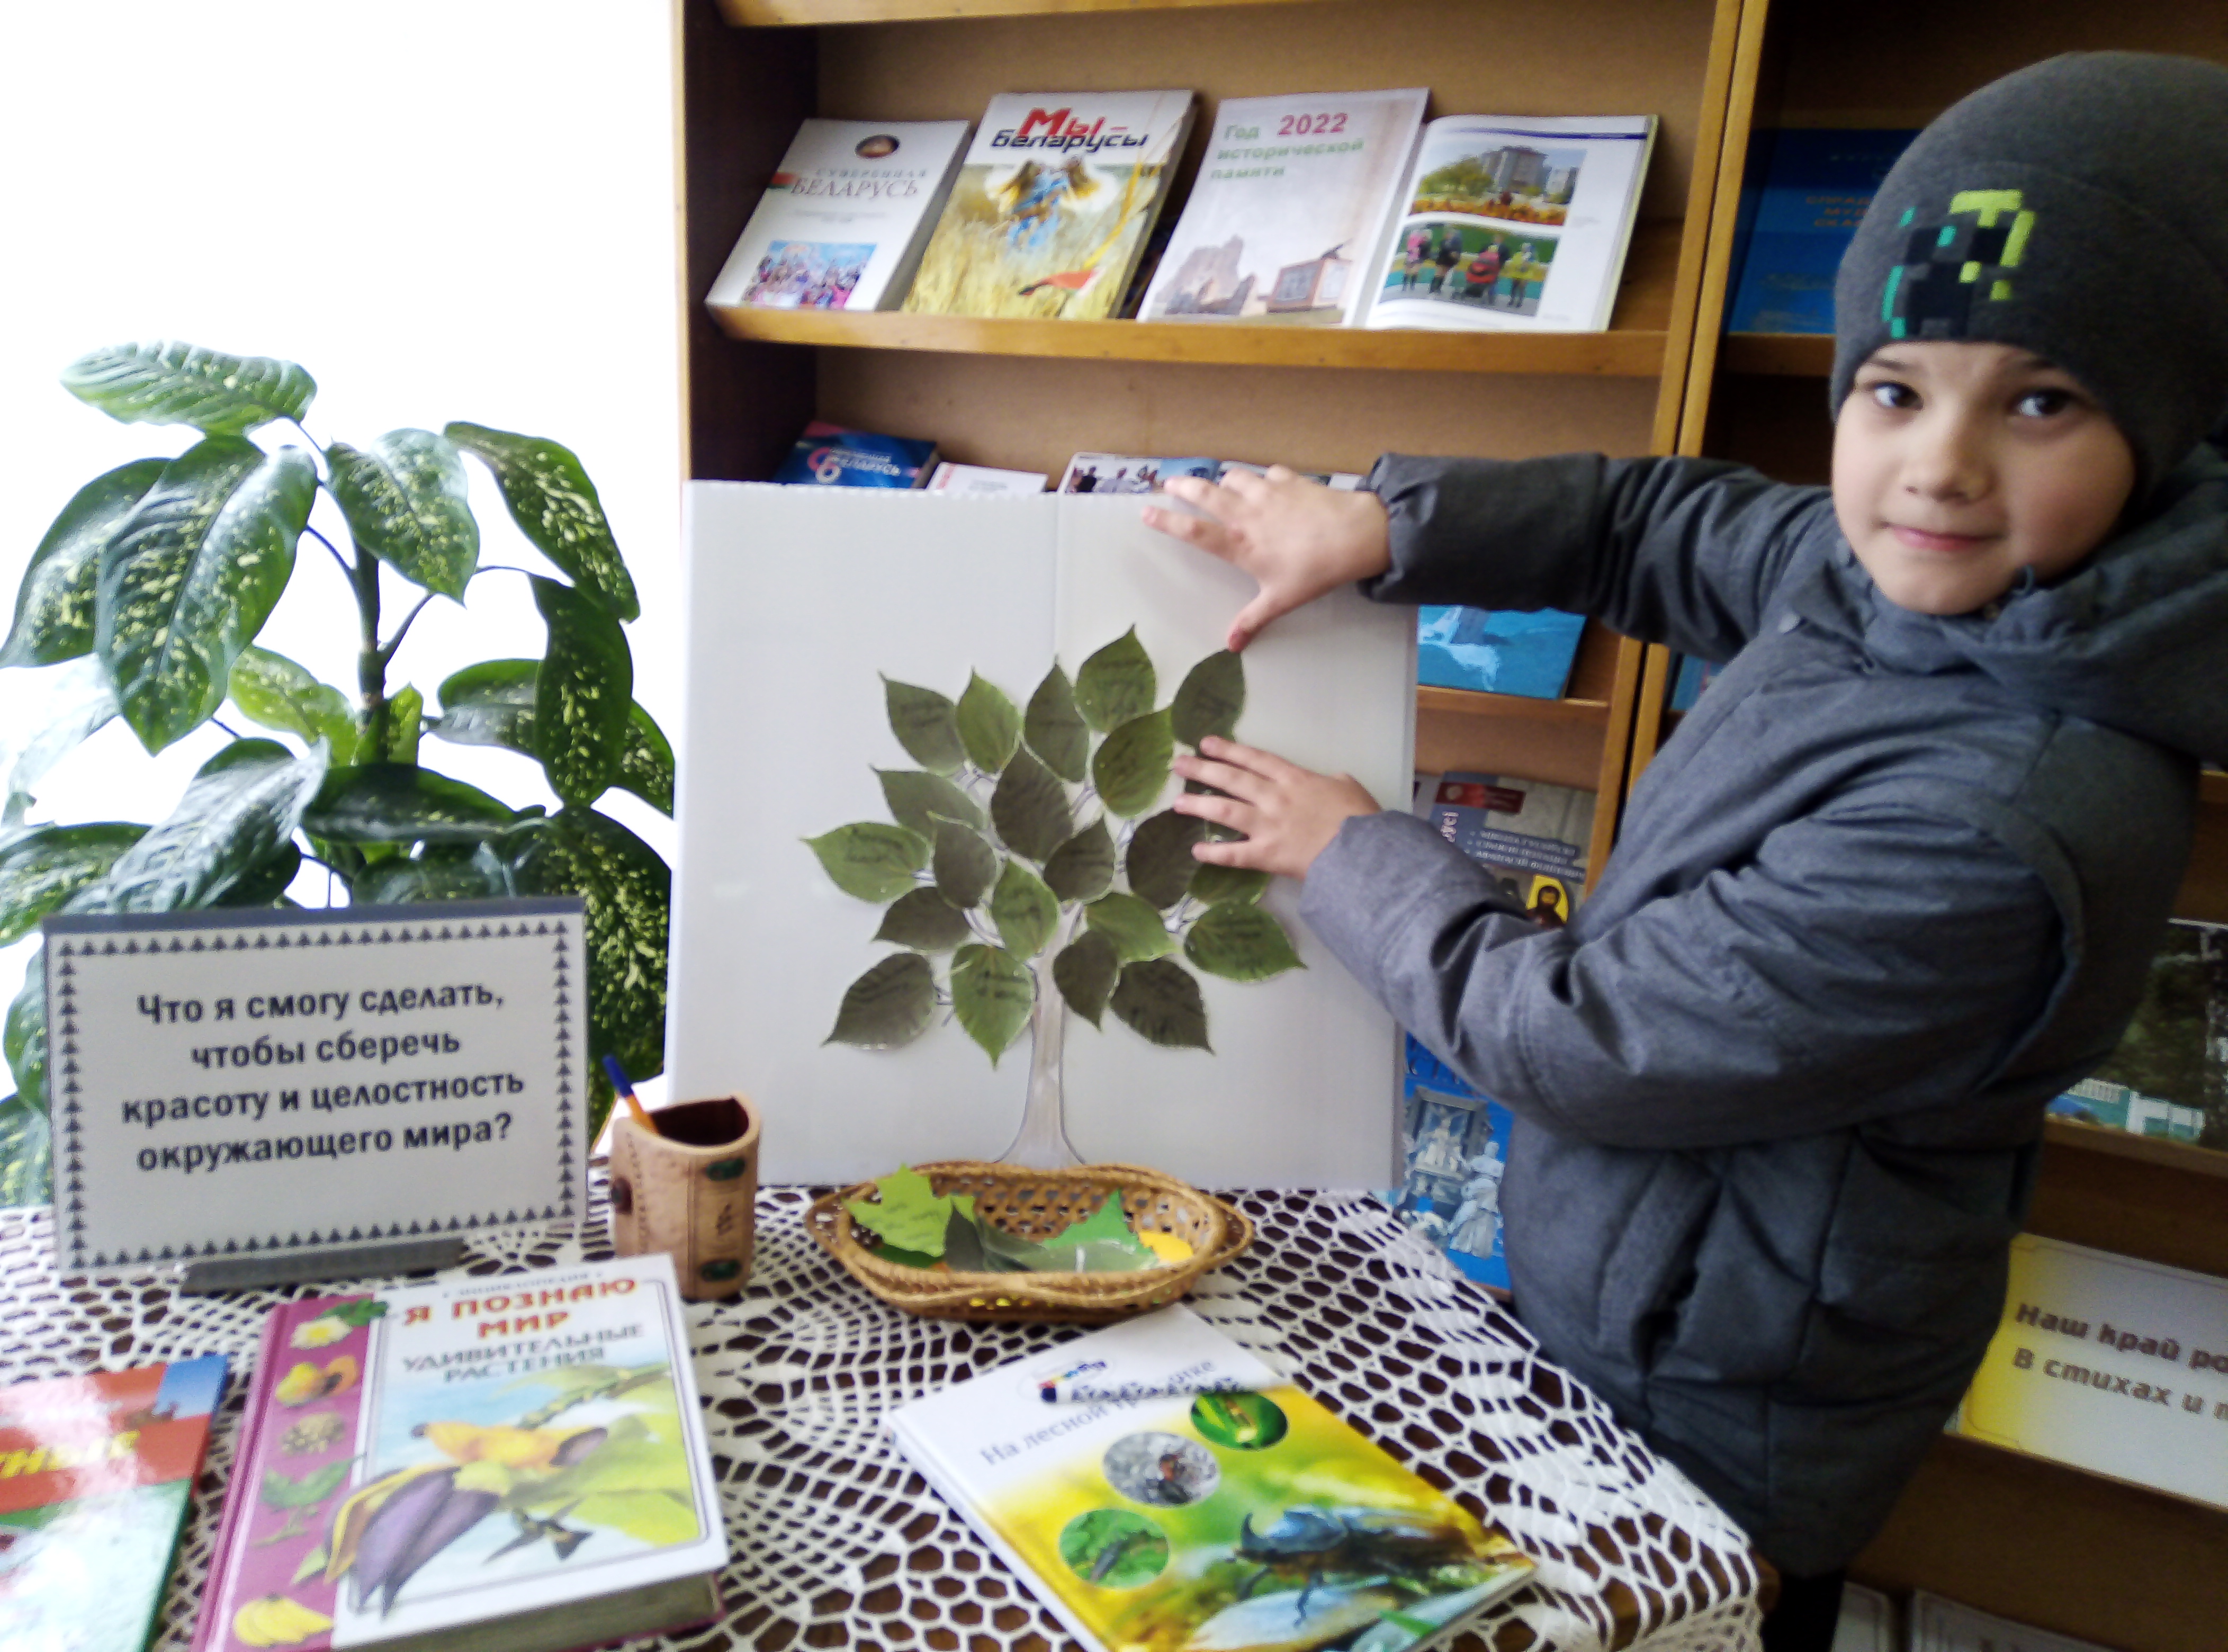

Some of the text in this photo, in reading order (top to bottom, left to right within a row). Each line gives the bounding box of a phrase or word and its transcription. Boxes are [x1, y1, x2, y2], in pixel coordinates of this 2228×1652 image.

[1276, 112, 1349, 136] 2022
[790, 177, 919, 199] БЕЛАРУСЬ
[137, 982, 505, 1025] Что я смогу сделать,
[191, 1030, 461, 1070] чтобы сберечь
[122, 1071, 524, 1128] красоту и целостность
[136, 1112, 512, 1174] окружающего мира?
[403, 1305, 430, 1325] Я
[452, 1278, 636, 1318] ПОЗНАЮ
[2015, 1302, 2090, 1340] Наш
[479, 1311, 570, 1338] МИР
[402, 1324, 643, 1370] УДИВИТЕЛЬНЫЕ
[444, 1347, 604, 1383] РАСТЕНИЯ
[2012, 1347, 2035, 1370] В
[2043, 1358, 2172, 1407] стихах
[2181, 1393, 2204, 1415] и
[980, 1444, 1020, 1466] На
[1023, 1402, 1109, 1450] лесной
